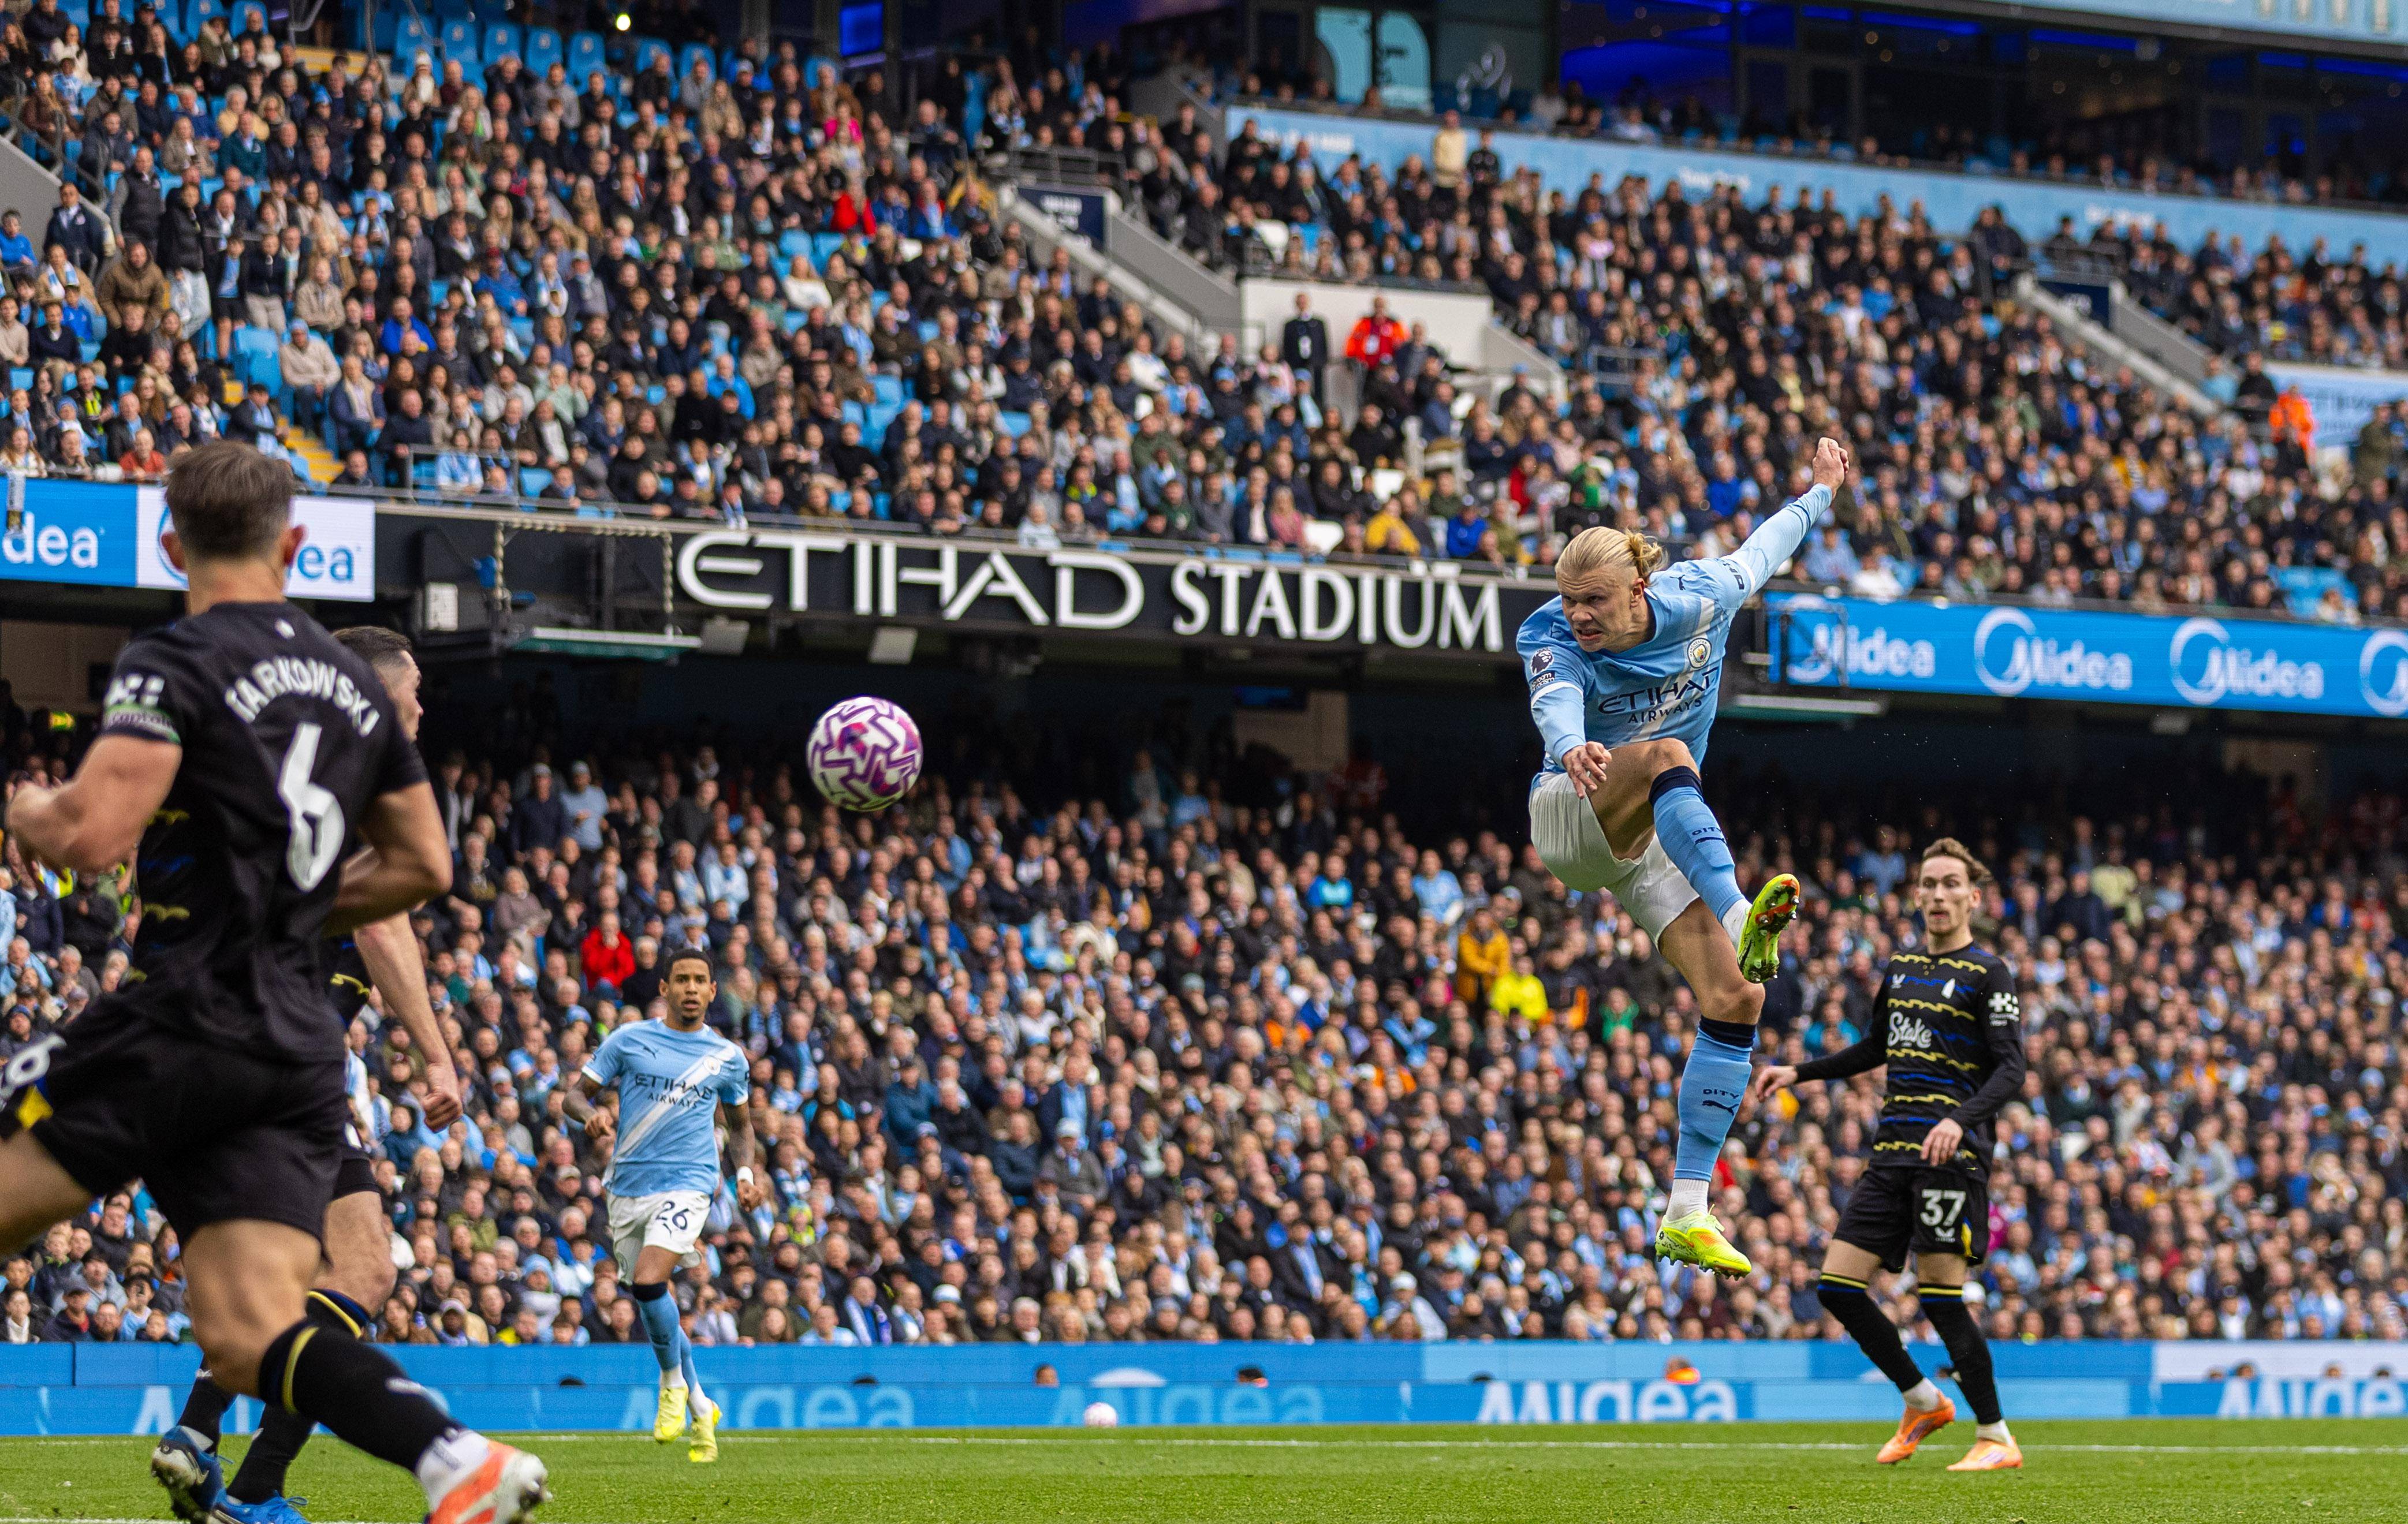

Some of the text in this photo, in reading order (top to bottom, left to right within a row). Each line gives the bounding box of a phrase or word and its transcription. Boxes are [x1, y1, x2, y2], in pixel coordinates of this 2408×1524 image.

[677, 532, 1503, 652] ETIHAD STADIUM
[1974, 606, 2133, 696] Midea
[2170, 617, 2325, 706] Midea
[225, 655, 380, 737] TARKOWSKI
[1628, 699, 1702, 724] AIRWAYS
[277, 722, 345, 893] 6
[1887, 1011, 1932, 1048] Stake
[635, 1073, 713, 1100] ETIHAD
[647, 1092, 699, 1110] AIRWAYS
[655, 1201, 688, 1231] 26
[1919, 1189, 1966, 1227] 37
